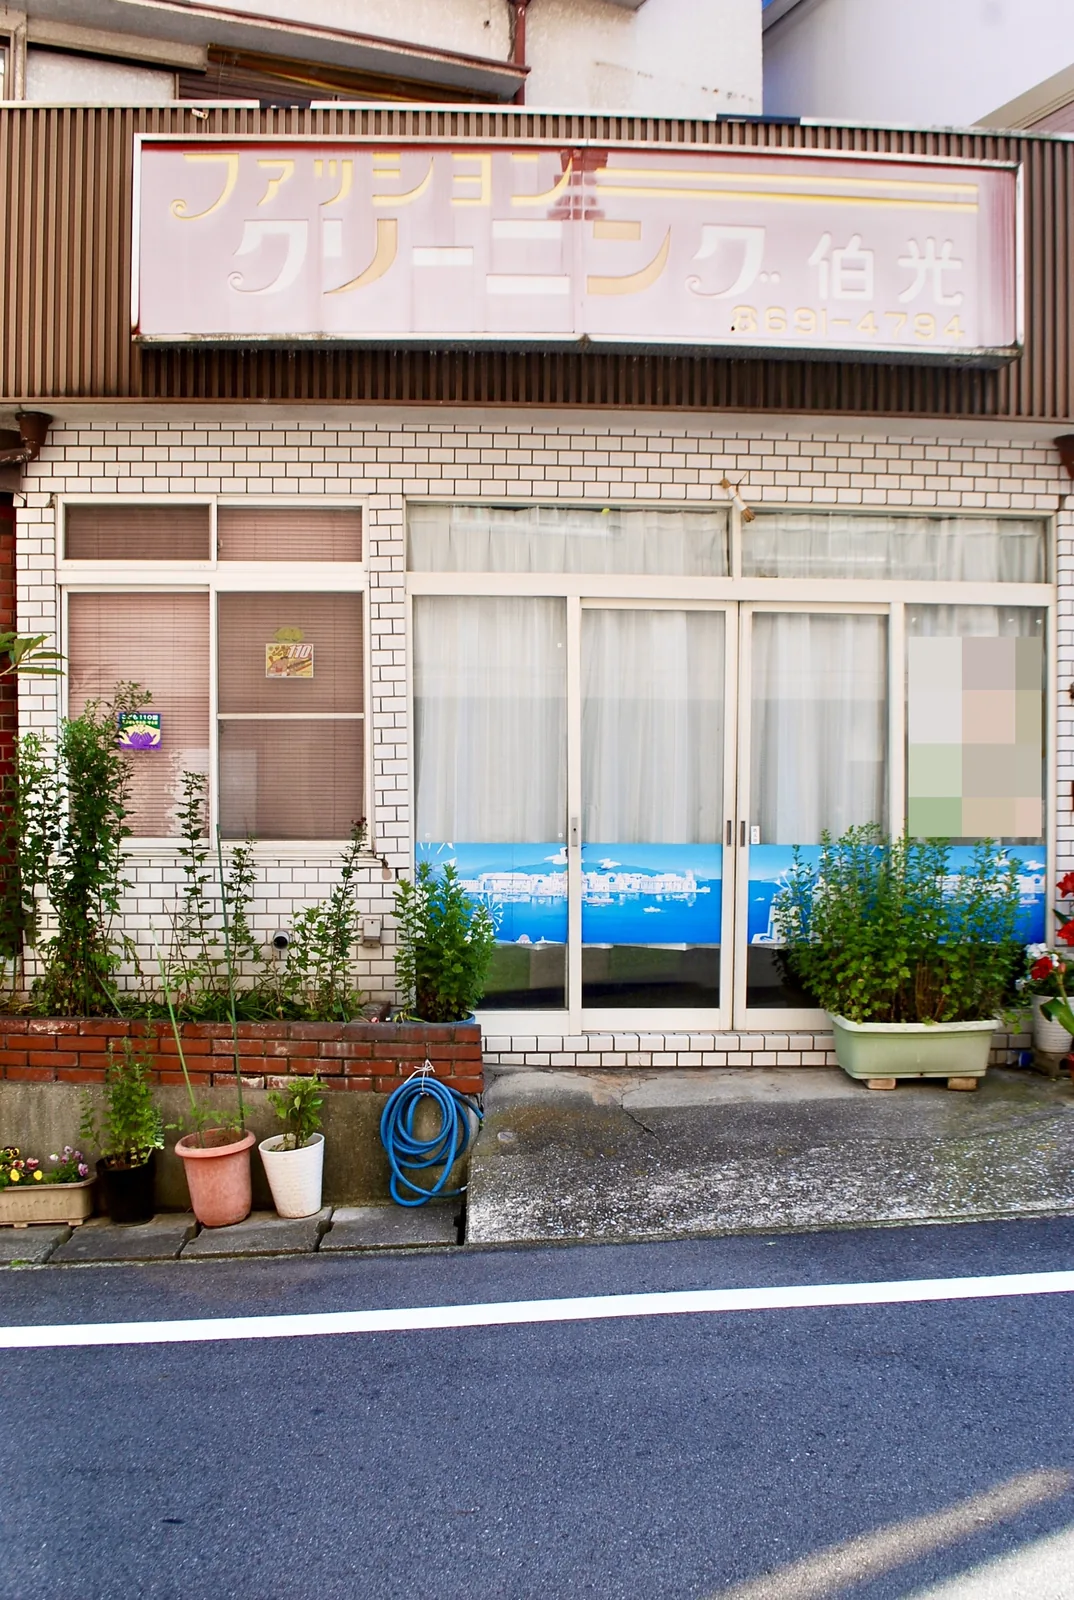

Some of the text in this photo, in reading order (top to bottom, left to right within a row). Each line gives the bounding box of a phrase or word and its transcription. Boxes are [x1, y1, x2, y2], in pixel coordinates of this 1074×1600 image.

[170, 152, 574, 221] ファッション
[227, 217, 965, 306] クリーニング 伯光
